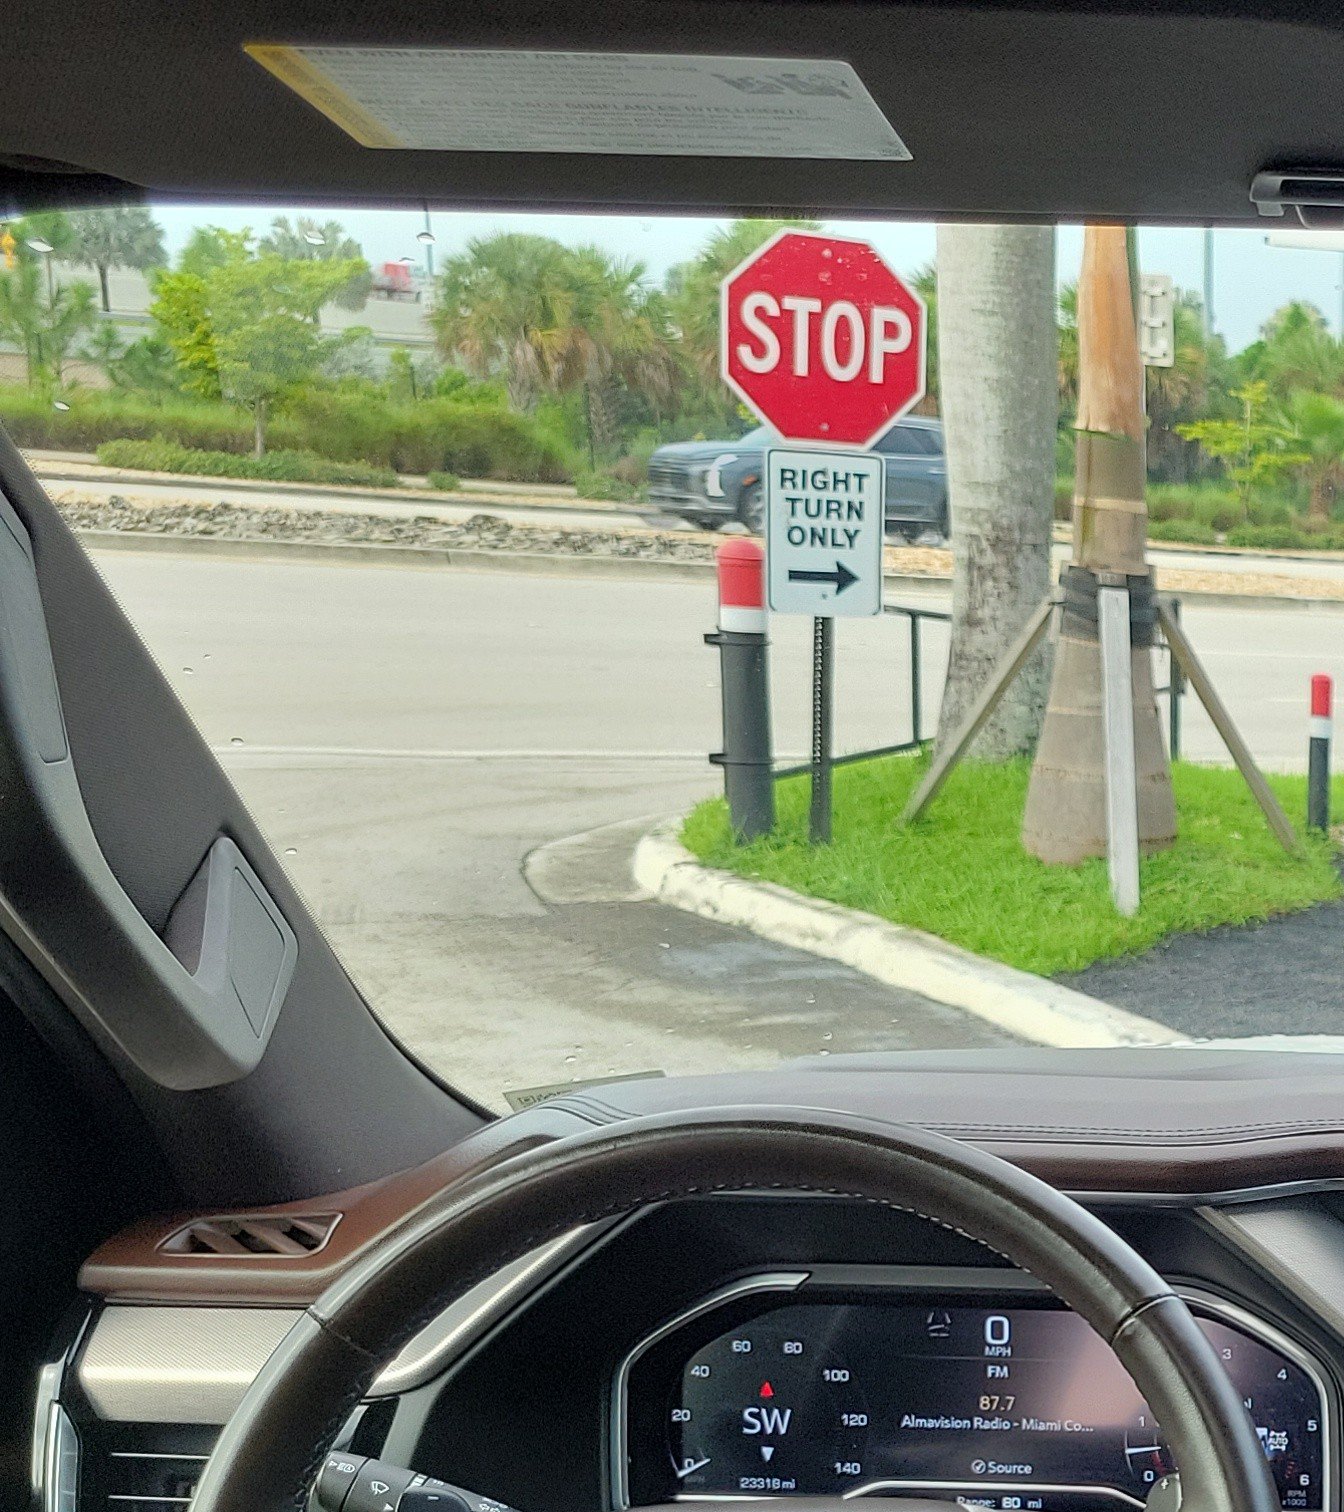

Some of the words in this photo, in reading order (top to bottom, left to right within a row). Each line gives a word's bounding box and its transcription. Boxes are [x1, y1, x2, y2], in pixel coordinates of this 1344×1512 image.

[737, 292, 912, 384] STOP
[780, 468, 871, 495] RIGHT
[785, 497, 864, 523] TURN
[786, 525, 862, 550] ONLY
[984, 1315, 1010, 1346] 0
[732, 1340, 751, 1352] 60
[984, 1346, 1012, 1357] MPH
[1222, 1348, 1232, 1360] 3
[690, 1365, 710, 1378] 40
[822, 1369, 850, 1382] 100
[987, 1365, 1009, 1379] FM
[1277, 1368, 1287, 1380] 4
[979, 1395, 1015, 1412] 87.7
[671, 1409, 691, 1422] 20
[742, 1407, 792, 1435] SW
[840, 1413, 868, 1426] 120
[1138, 1416, 1146, 1427] 1
[901, 1414, 971, 1430] Almavision
[973, 1417, 1011, 1430] Radio
[1021, 1419, 1061, 1431] Miami
[1307, 1420, 1317, 1431] 5
[834, 1462, 861, 1475] 140
[988, 1460, 1032, 1475] Source
[1143, 1471, 1154, 1482] 0
[1300, 1474, 1310, 1486] 6
[1002, 1497, 1021, 1509] 80
[1027, 1497, 1042, 1509] mi
